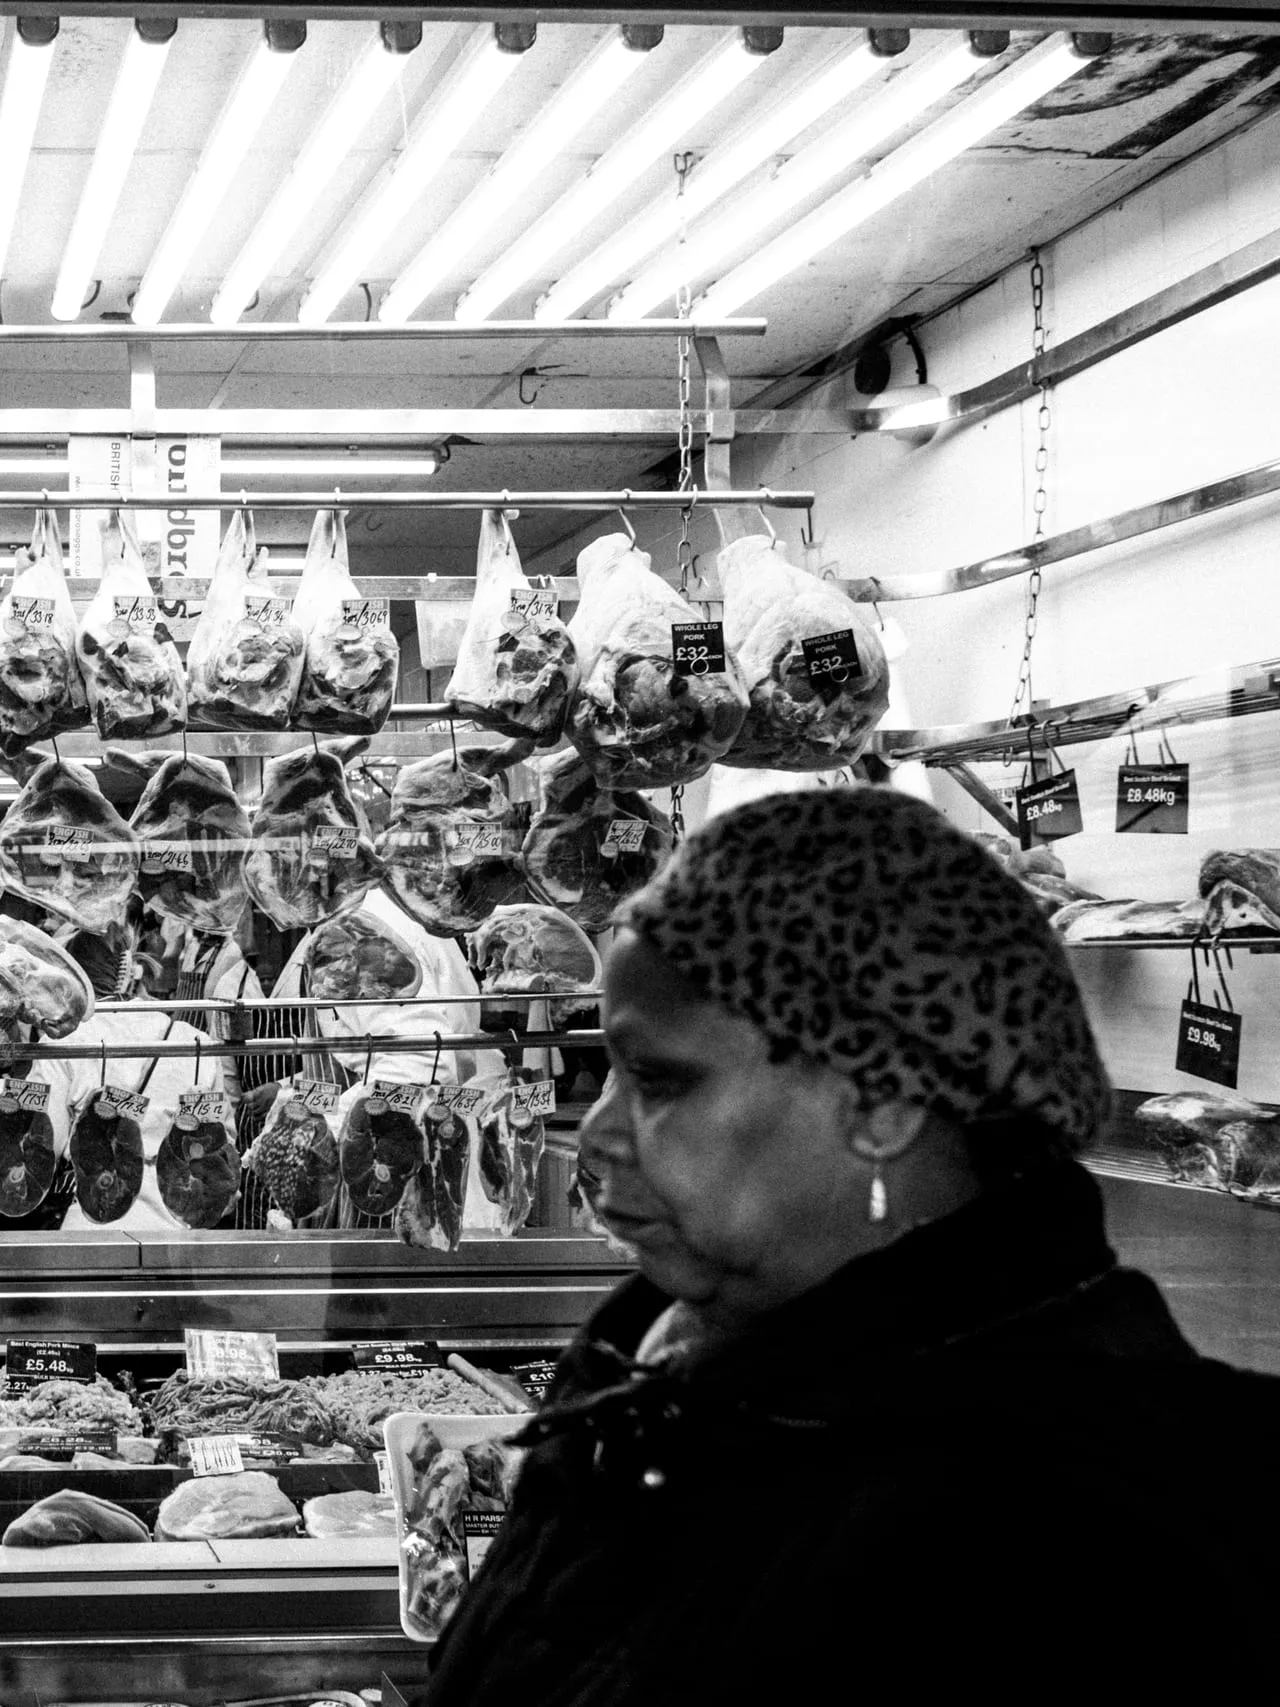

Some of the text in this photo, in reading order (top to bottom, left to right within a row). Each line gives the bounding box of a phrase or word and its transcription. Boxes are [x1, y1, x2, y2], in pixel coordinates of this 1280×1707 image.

[111, 442, 120, 491] BRITISH
[804, 631, 849, 647] WHOLE LEG
[676, 646, 709, 661] £32
[815, 644, 838, 654] PORK
[810, 656, 842, 675] £32
[1127, 788, 1175, 805] £8.48kg
[480, 1514, 504, 1522] PARS
